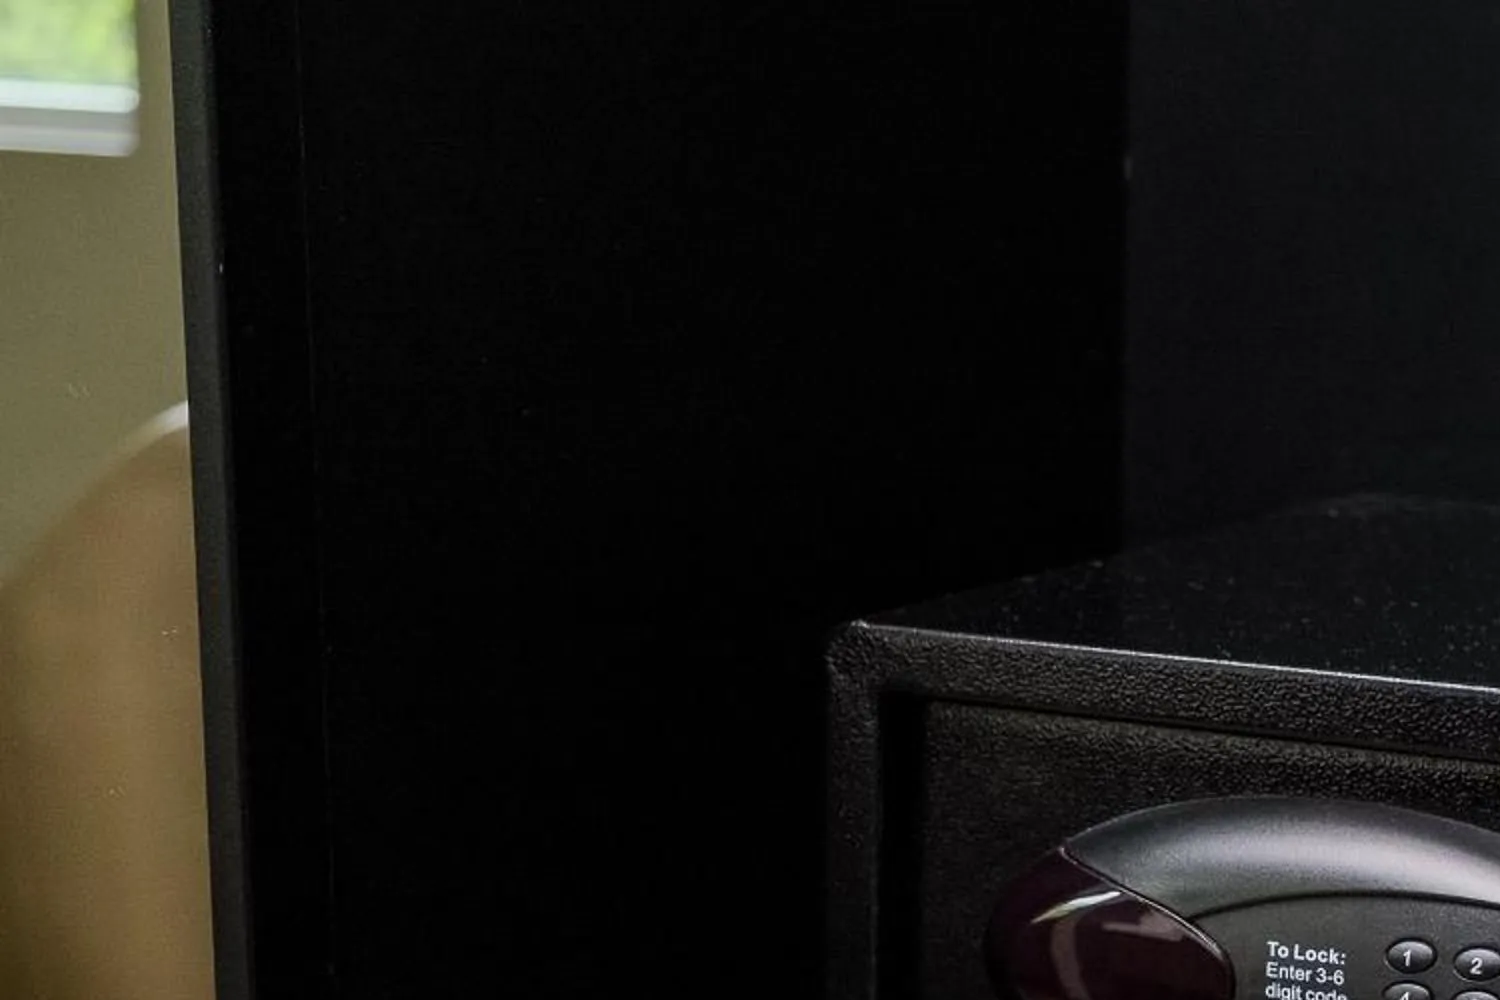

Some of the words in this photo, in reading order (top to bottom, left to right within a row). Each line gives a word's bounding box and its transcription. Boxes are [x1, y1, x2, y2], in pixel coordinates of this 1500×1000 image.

[1266, 942, 1289, 959] To
[1294, 947, 1346, 965] Lock:
[1403, 951, 1411, 966] 1
[1471, 958, 1482, 974] 2
[1266, 962, 1312, 981] Enter
[1315, 969, 1344, 985] 3-6
